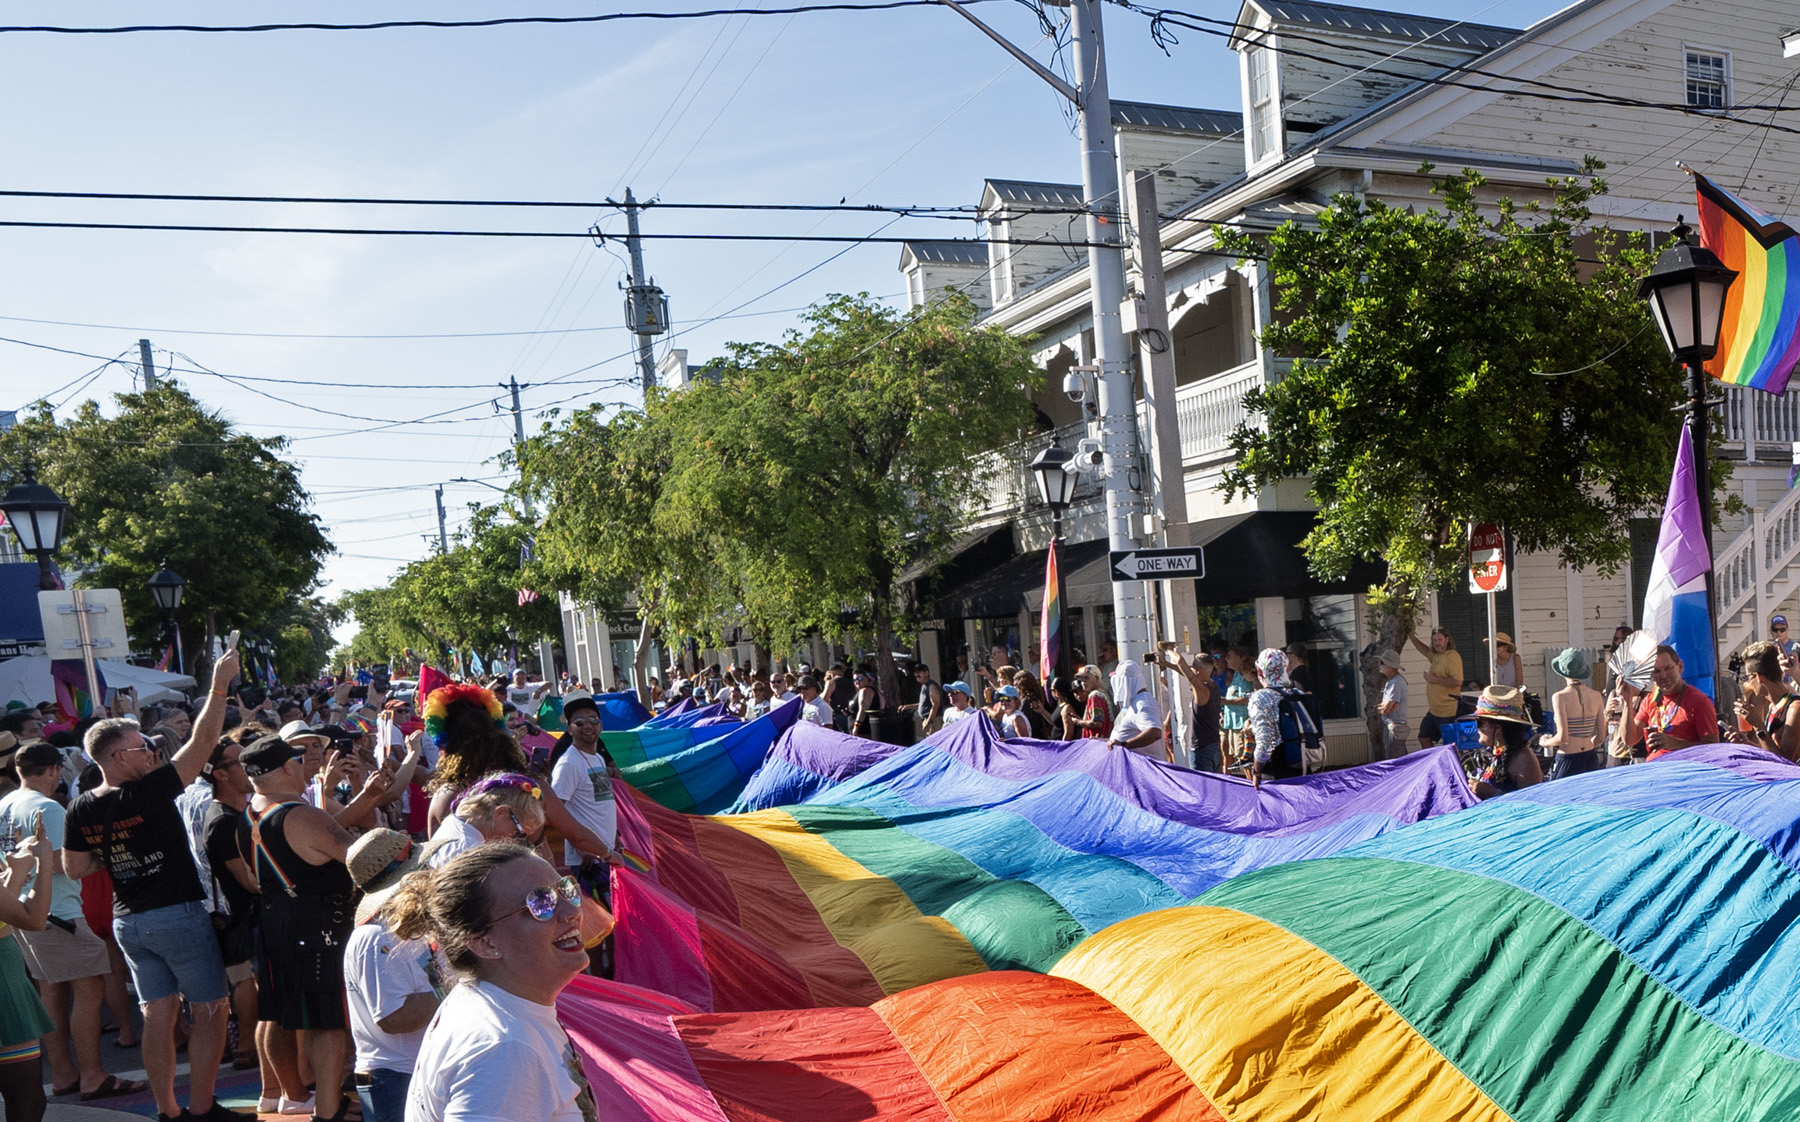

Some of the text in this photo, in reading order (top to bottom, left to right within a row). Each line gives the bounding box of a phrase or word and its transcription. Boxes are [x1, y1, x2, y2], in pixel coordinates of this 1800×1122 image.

[1474, 532, 1499, 547] DO NOT
[1137, 556, 1192, 571] ONE WAY
[609, 623, 640, 633] ock Com
[0, 647, 17, 655] ans
[143, 851, 164, 865] AND
